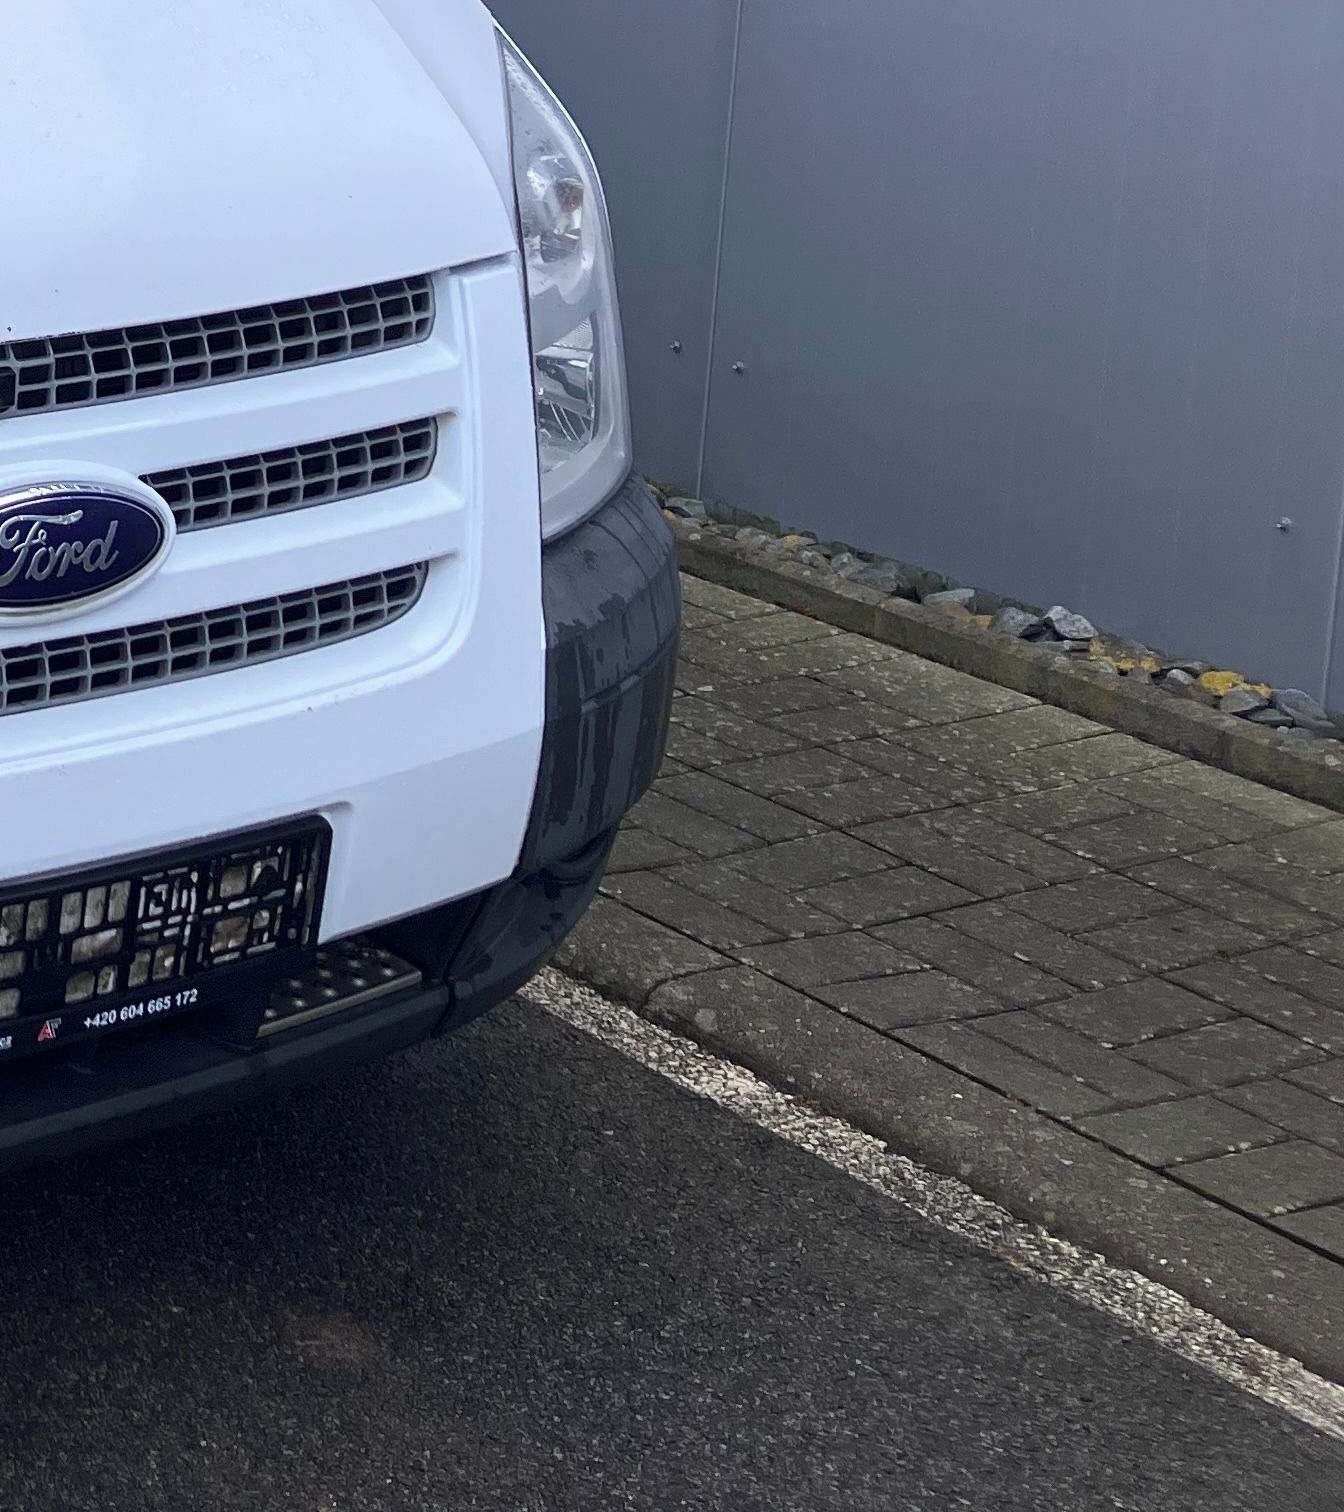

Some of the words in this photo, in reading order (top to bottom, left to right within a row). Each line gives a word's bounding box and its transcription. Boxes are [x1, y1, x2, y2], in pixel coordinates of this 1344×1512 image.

[83, 1009, 117, 1029] +420
[119, 1001, 144, 1022] 604
[147, 995, 172, 1014] 665
[175, 987, 199, 1007] 172
